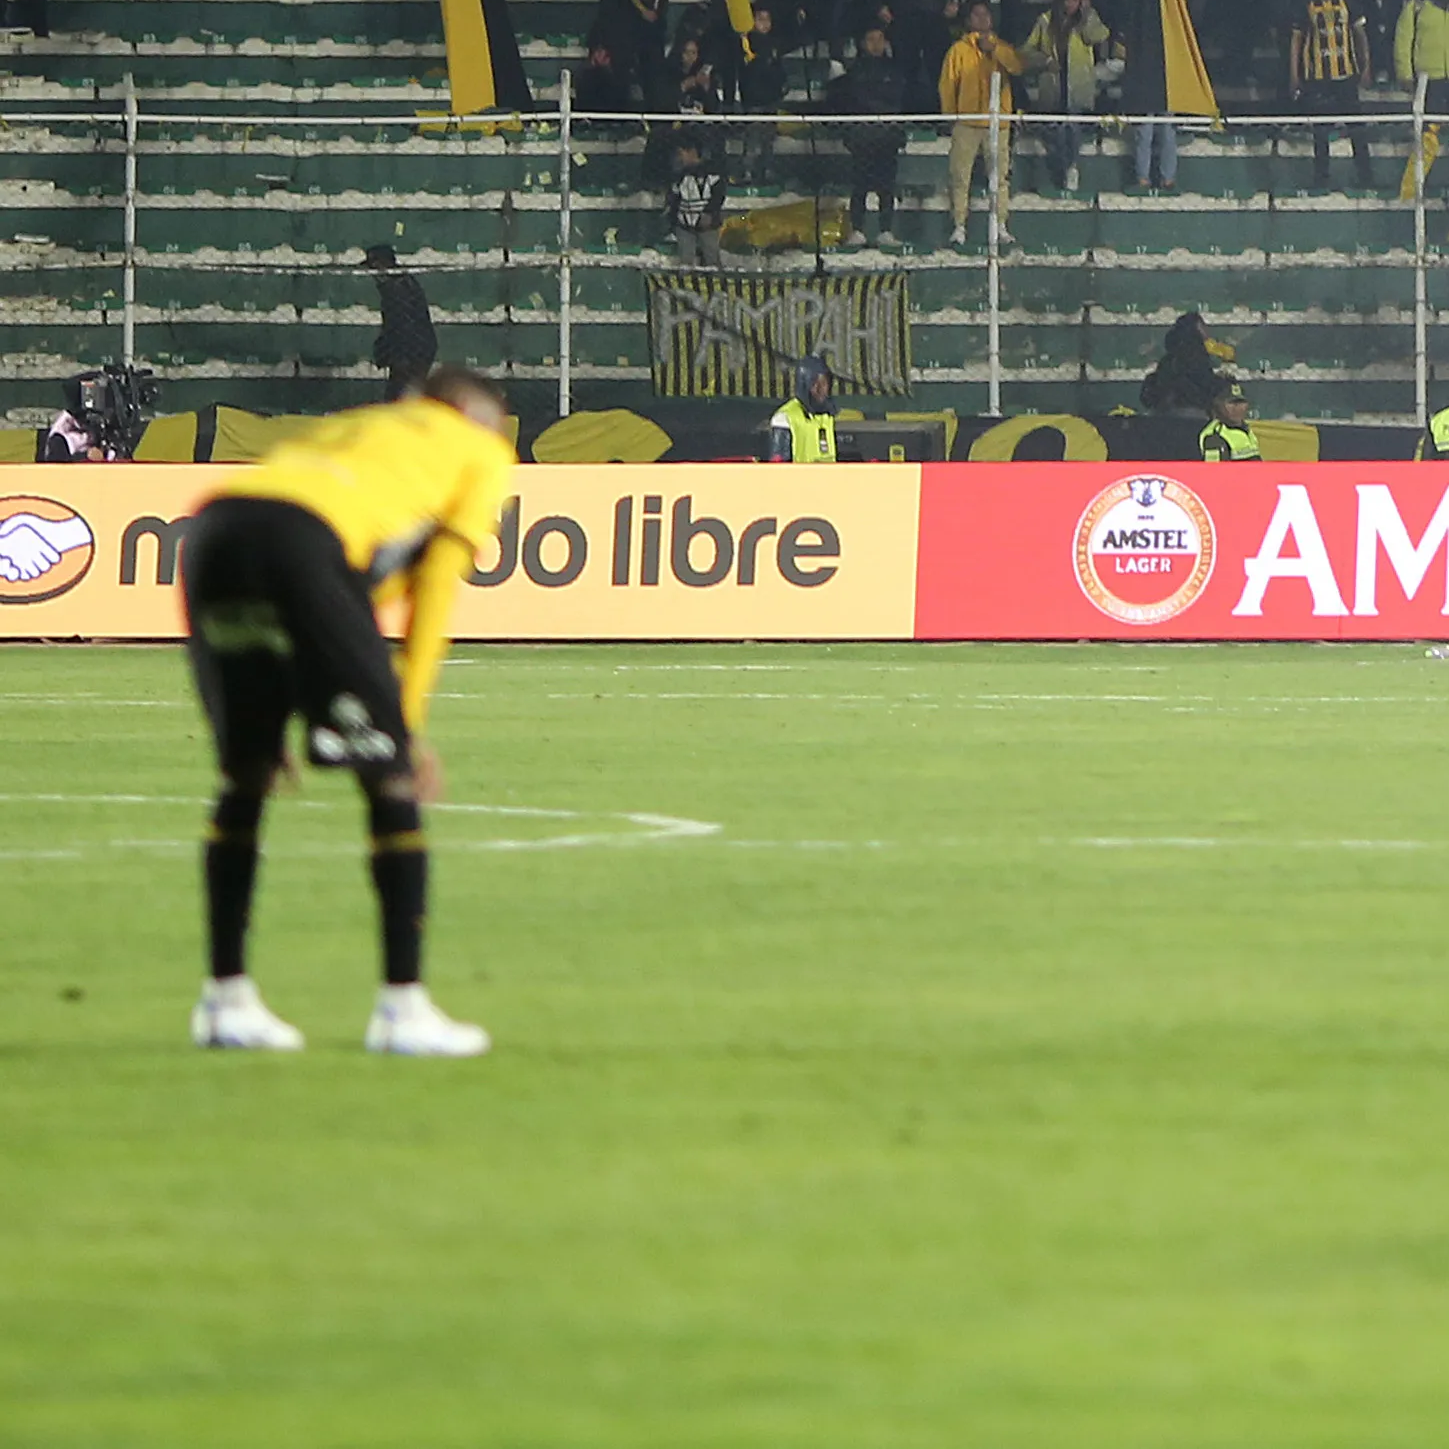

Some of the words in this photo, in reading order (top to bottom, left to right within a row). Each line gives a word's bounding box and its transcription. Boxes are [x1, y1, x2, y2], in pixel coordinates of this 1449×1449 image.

[612, 496, 841, 587] libre
[1102, 528, 1189, 550] AMSTEL
[1114, 556, 1172, 574] LAGER
